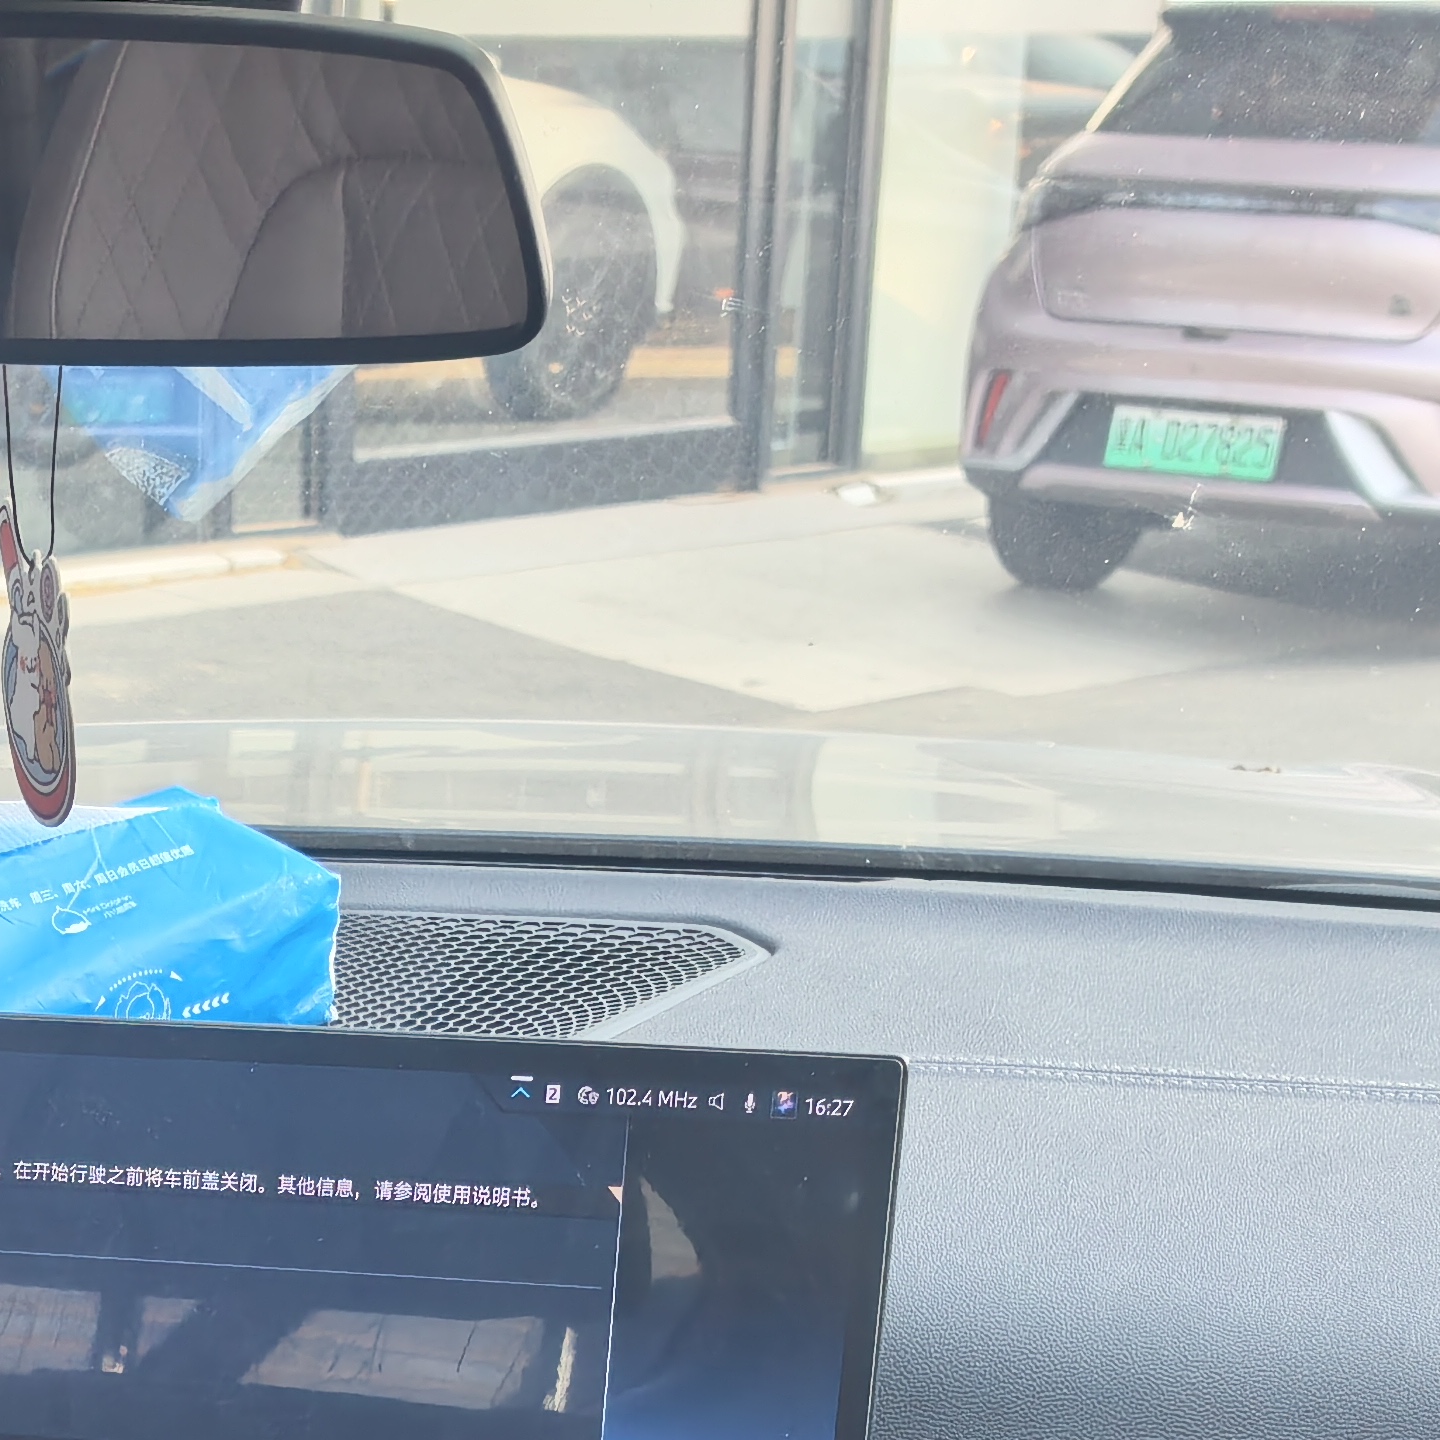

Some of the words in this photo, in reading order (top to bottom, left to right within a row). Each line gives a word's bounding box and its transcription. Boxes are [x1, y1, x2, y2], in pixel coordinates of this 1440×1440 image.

[606, 1087, 652, 1107] 102.4
[658, 1090, 698, 1110] MHz
[805, 1098, 855, 1118] 16:27
